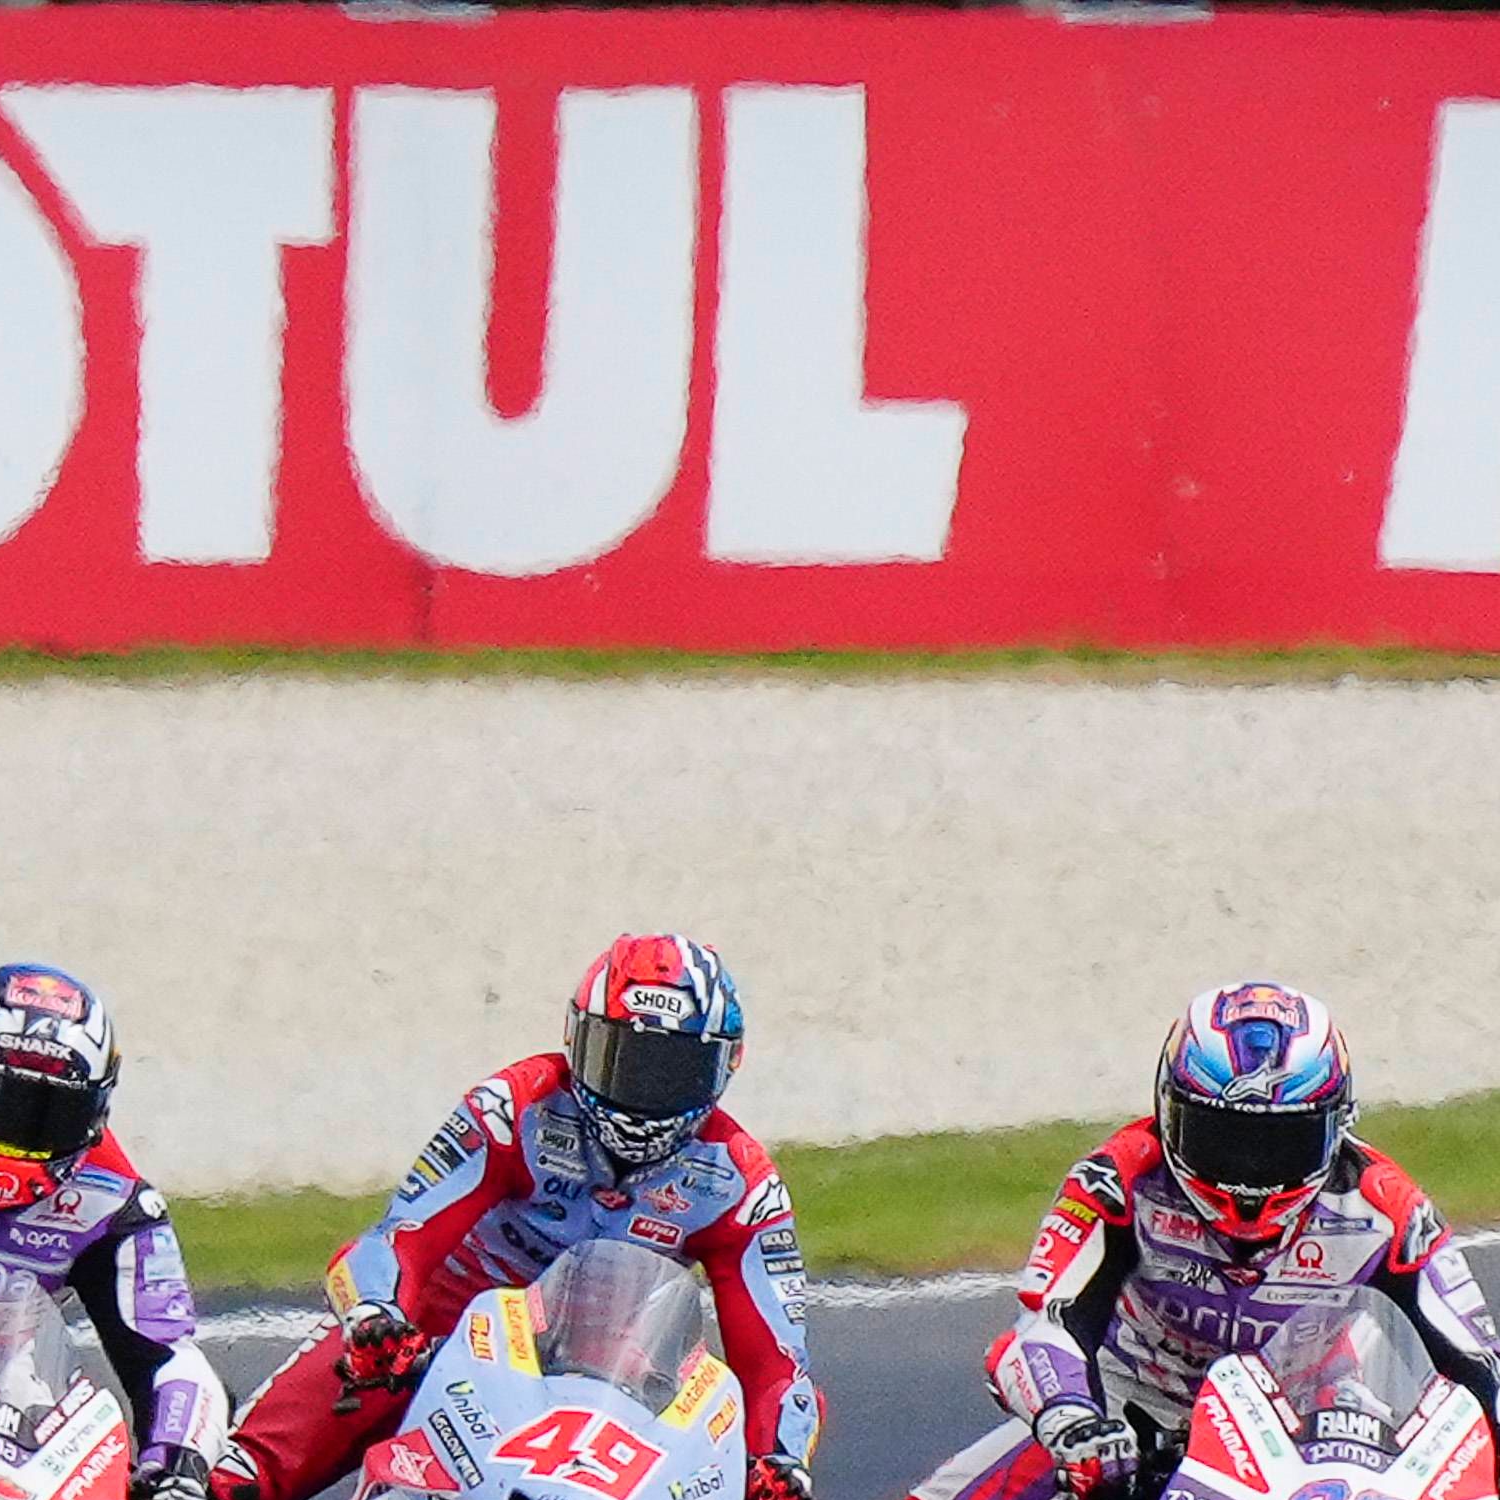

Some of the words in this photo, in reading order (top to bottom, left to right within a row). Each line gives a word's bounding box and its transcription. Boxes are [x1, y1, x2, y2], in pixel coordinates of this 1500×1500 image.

[633, 990, 682, 1014] SHOEI
[1044, 1214, 1083, 1244] TUL
[1027, 1347, 1062, 1399] prima
[446, 1380, 497, 1441] Unibat
[1202, 1394, 1257, 1480] PRAMAC
[1316, 1411, 1380, 1443] FIAMM
[1309, 1442, 1382, 1468] prima
